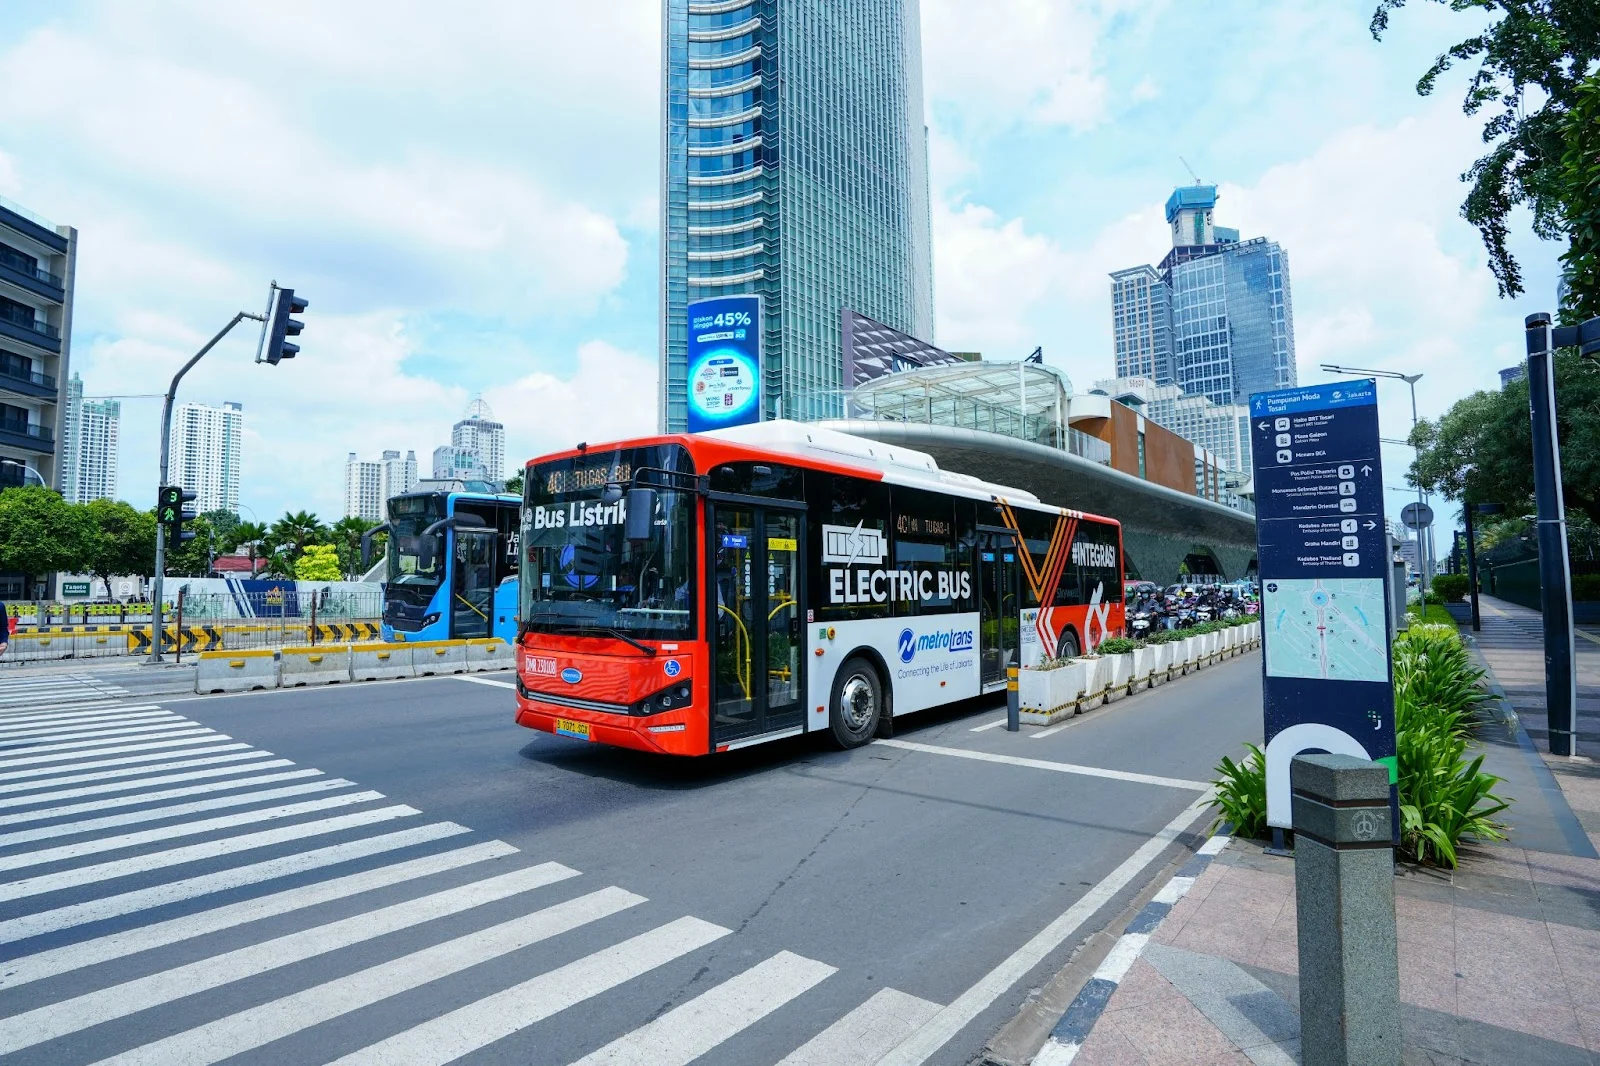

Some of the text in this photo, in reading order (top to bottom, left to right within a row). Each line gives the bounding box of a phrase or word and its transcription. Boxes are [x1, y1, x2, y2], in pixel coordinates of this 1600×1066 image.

[713, 312, 751, 327] 45%
[1267, 396, 1300, 406] Pumpunan
[1302, 393, 1320, 401] Moda
[1267, 405, 1287, 413] Tosari
[547, 471, 562, 494] 4C
[170, 491, 177, 502] 3
[535, 505, 565, 529] Bus
[1072, 542, 1116, 568] #INTEGRASI
[830, 568, 971, 604] ELECTRIC BUS
[917, 629, 973, 652] metrotrans
[898, 666, 930, 680] Connecting
[931, 664, 940, 674] the
[940, 662, 948, 672] Life
[949, 661, 955, 670] of
[563, 721, 576, 732] 7071
